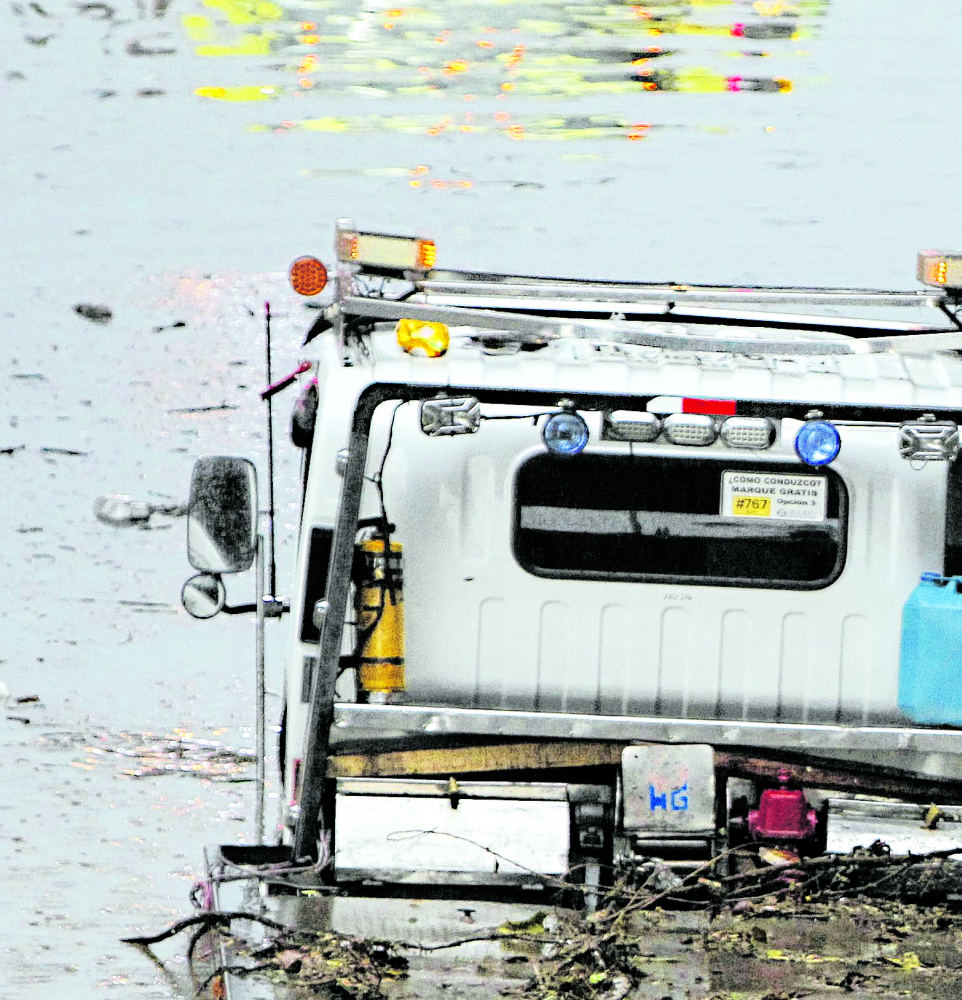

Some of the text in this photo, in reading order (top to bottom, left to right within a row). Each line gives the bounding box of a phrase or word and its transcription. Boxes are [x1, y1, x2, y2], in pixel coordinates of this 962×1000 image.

[764, 477, 821, 487] CONDUZCO?
[731, 486, 818, 496] MARQUE GRATIS
[736, 498, 767, 509] #767
